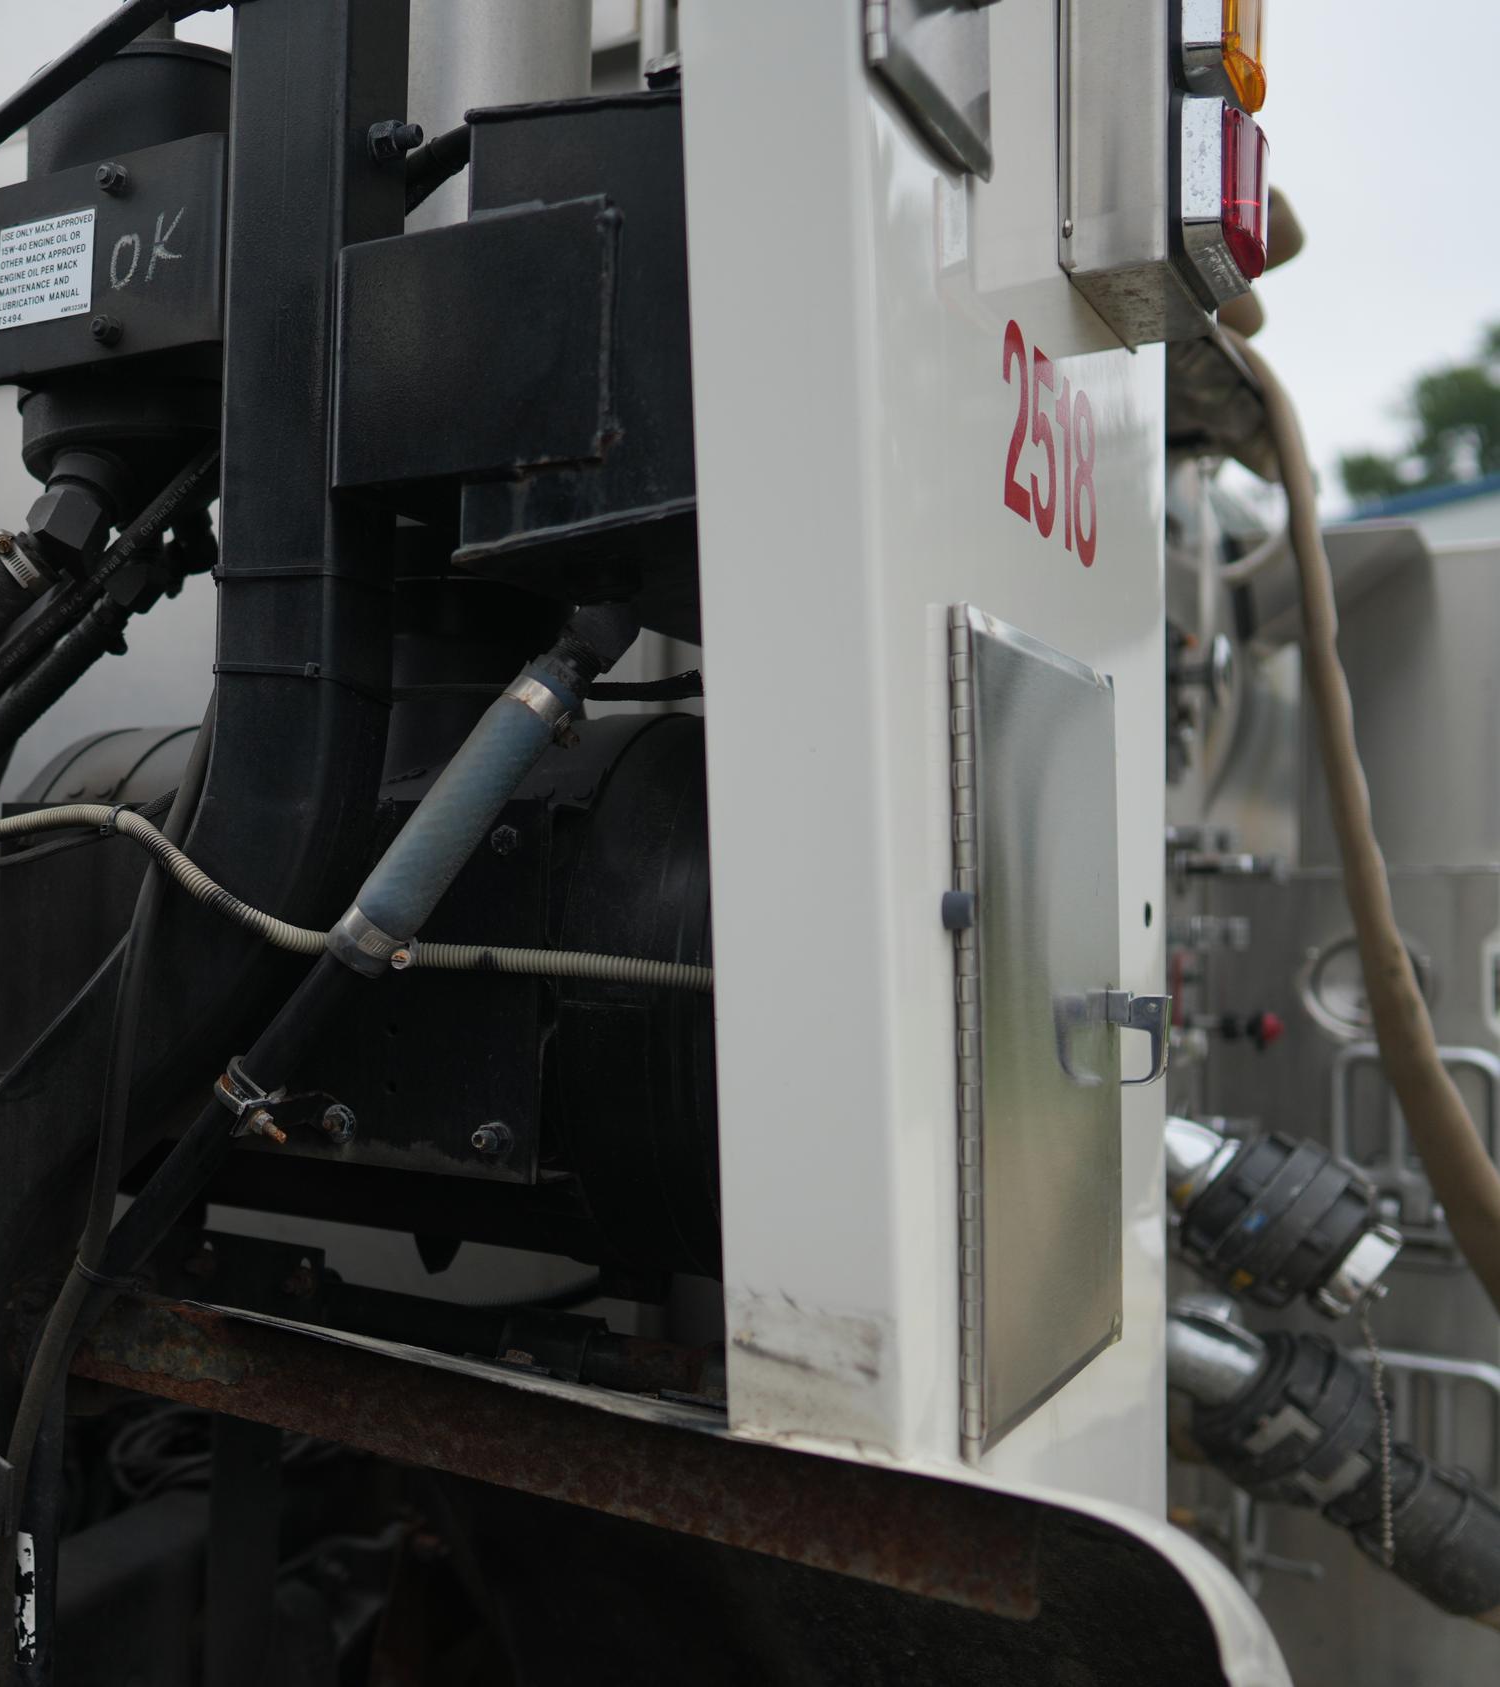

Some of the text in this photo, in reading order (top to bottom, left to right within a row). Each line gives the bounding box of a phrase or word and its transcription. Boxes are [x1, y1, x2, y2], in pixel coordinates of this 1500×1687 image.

[2, 214, 93, 241] USE ONLY MACK APPROVED
[2, 231, 81, 255] 15W-40 ENGINE OIL OR
[110, 206, 187, 290] OK
[1, 244, 86, 269] OTHER MACK APPROVED
[0, 261, 78, 284] ENGINE OIL PER MACK
[0, 276, 69, 297] MAINTENANCE AND
[0, 289, 79, 311] LUBRICATION MANUAL
[1002, 319, 1097, 568] 2518
